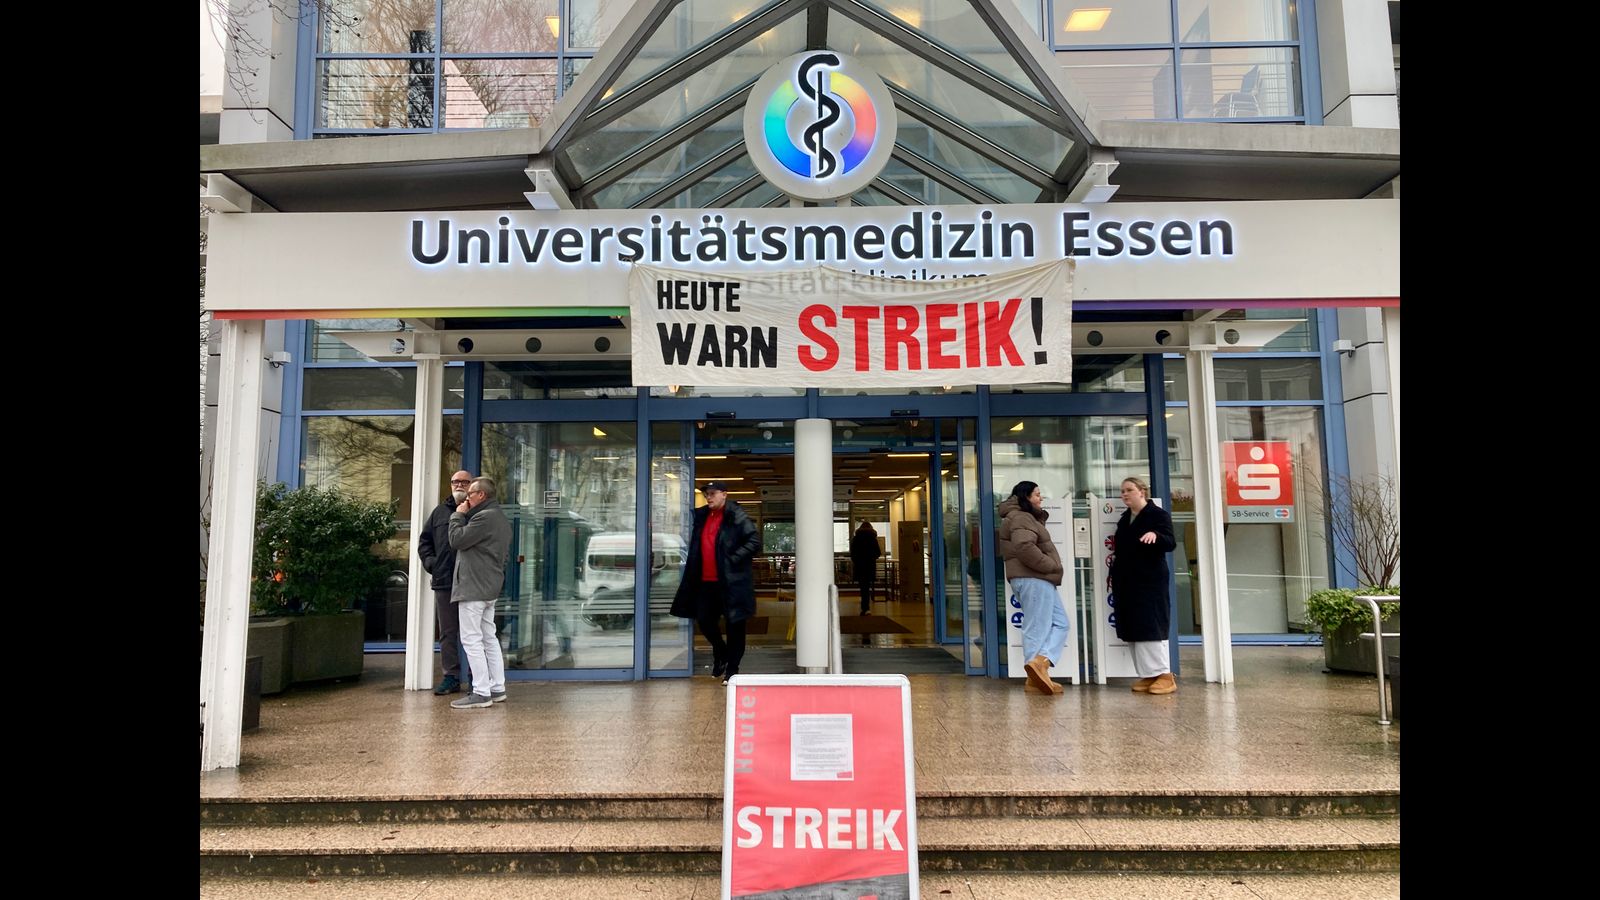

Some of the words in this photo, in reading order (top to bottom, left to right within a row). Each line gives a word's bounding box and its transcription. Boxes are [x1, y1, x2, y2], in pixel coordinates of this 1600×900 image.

[410, 210, 1035, 265] Universitätsmedizin
[1062, 211, 1234, 258] Essen
[656, 279, 741, 313] HEUTE
[656, 322, 779, 369] WARN
[797, 297, 1049, 372] STREIK!
[1231, 510, 1270, 518] SB-Service
[735, 686, 757, 774] Heute:
[736, 805, 905, 851] STREIK
